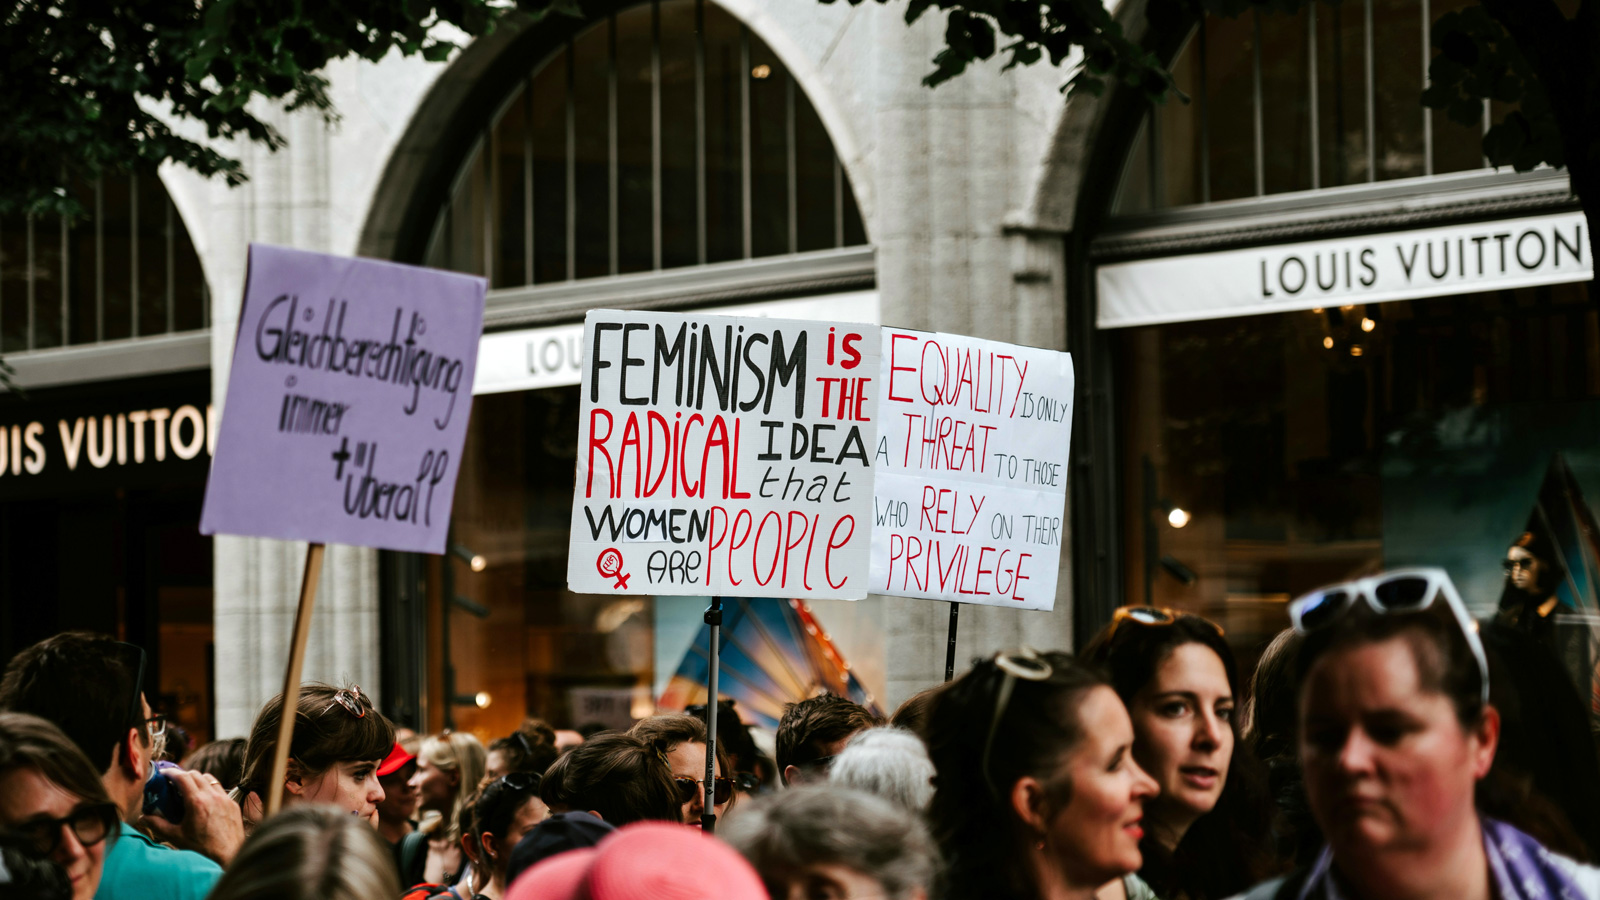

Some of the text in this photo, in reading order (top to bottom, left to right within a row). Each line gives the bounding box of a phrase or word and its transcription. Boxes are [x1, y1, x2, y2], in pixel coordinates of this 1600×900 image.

[1260, 224, 1583, 298] LOUIS VUITTON
[255, 294, 463, 431] Gleichberechtigung
[888, 333, 1068, 424] EQUALITY IS ONLY
[278, 374, 351, 436] immer
[816, 377, 872, 422] THE
[57, 403, 213, 471] VUITTO
[757, 420, 870, 467] IDEA
[875, 413, 1062, 487] A THREAT TO THOSE
[343, 441, 449, 528] Überall
[758, 466, 851, 502] that
[875, 485, 1060, 547] WHO RELY ON THEIR
[584, 504, 710, 544] WOMEN
[886, 534, 1033, 602] PRIVILEGE
